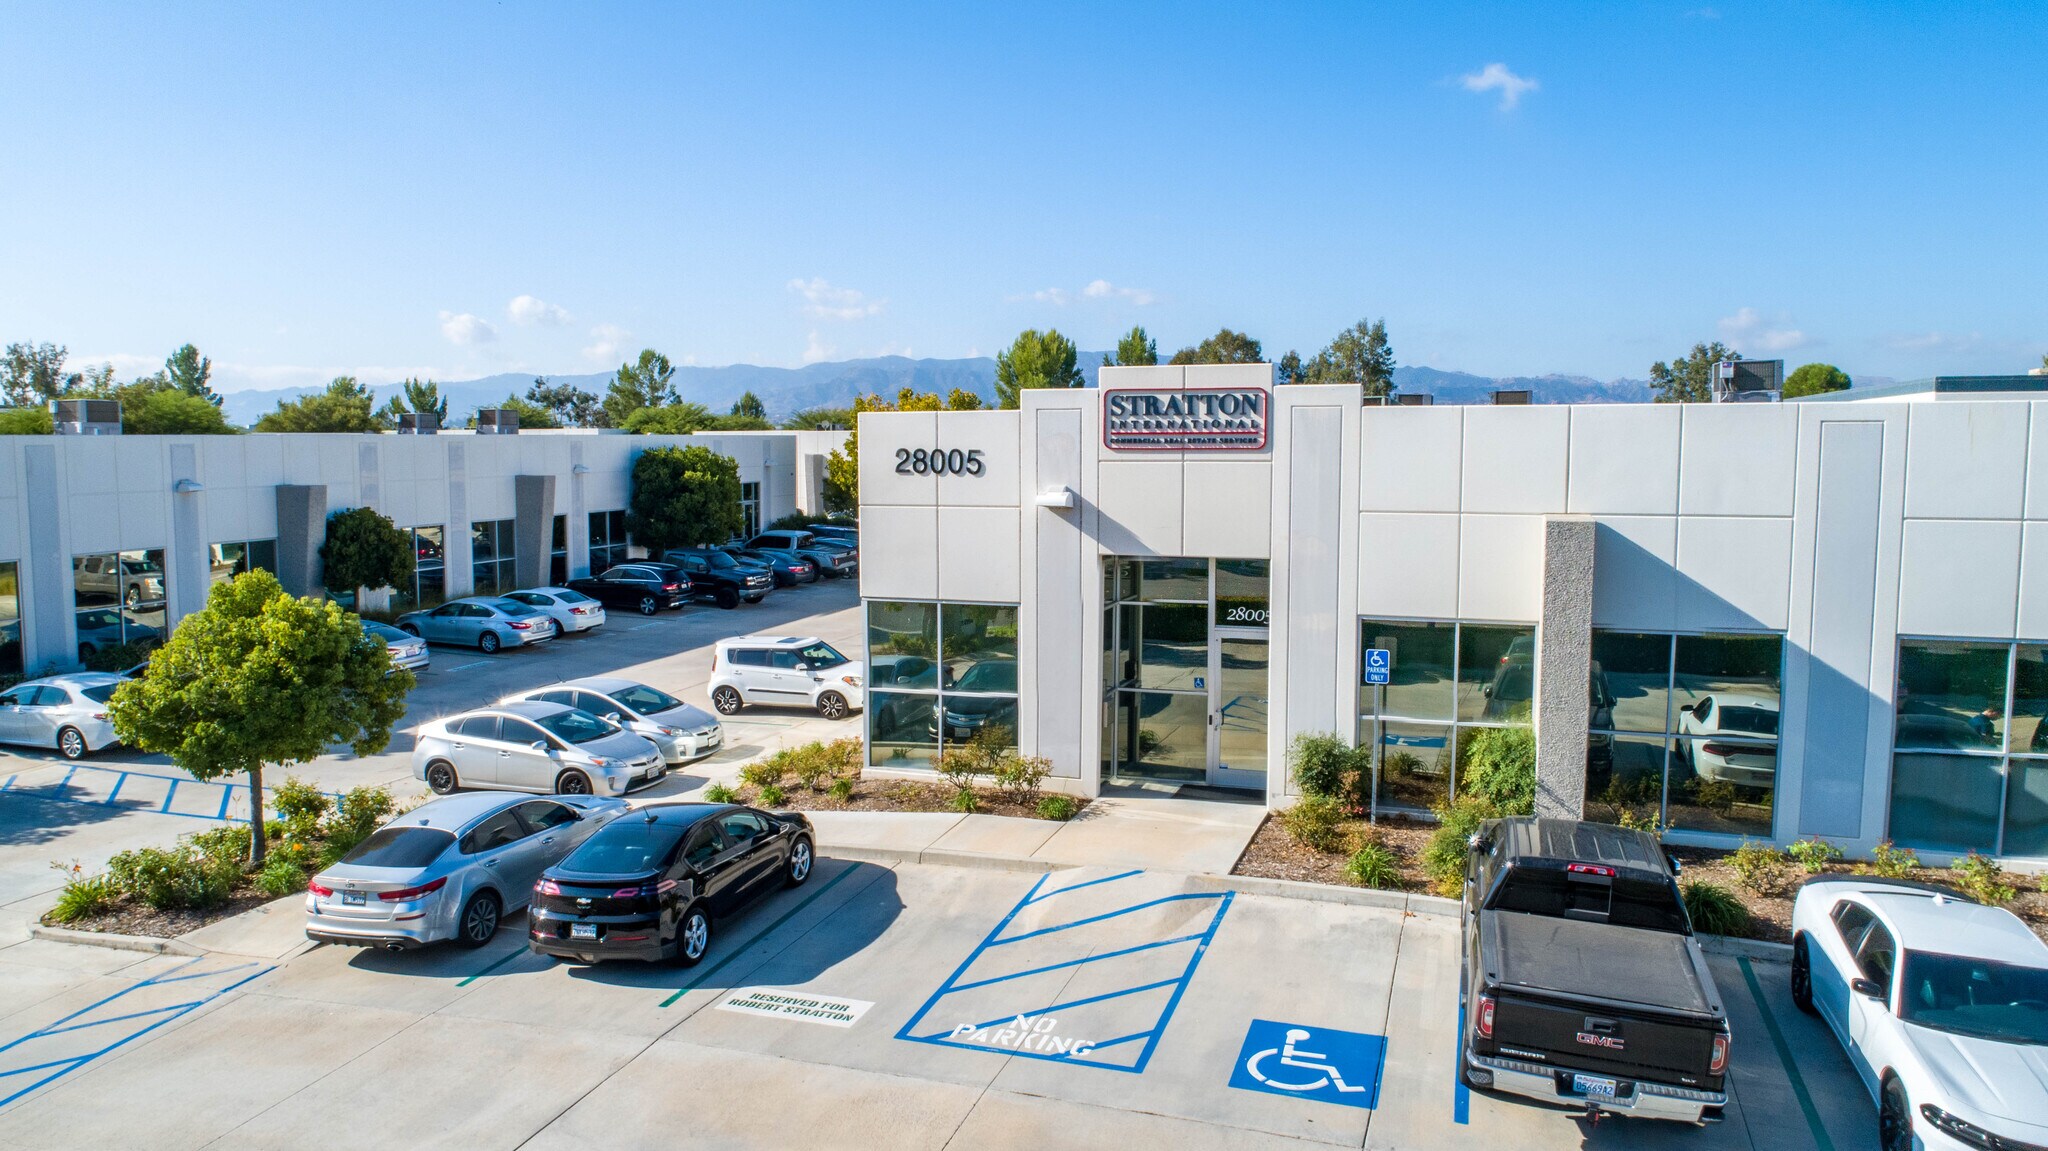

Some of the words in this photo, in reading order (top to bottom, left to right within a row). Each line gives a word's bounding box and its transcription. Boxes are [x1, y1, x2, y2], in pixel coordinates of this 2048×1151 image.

[1110, 393, 1260, 417] STRATTON
[1110, 419, 1260, 430] INTERNATIONAL
[895, 447, 983, 475] 28005
[1367, 666, 1389, 674] PARKING
[727, 998, 784, 1012] ROBERT
[783, 1006, 855, 1022] STRATTON
[749, 993, 819, 1008] RESERVED
[821, 1002, 850, 1012] FOR
[1008, 1014, 1058, 1033] NO
[949, 1023, 1096, 1056] PARKING
[1576, 1032, 1625, 1050] GMC
